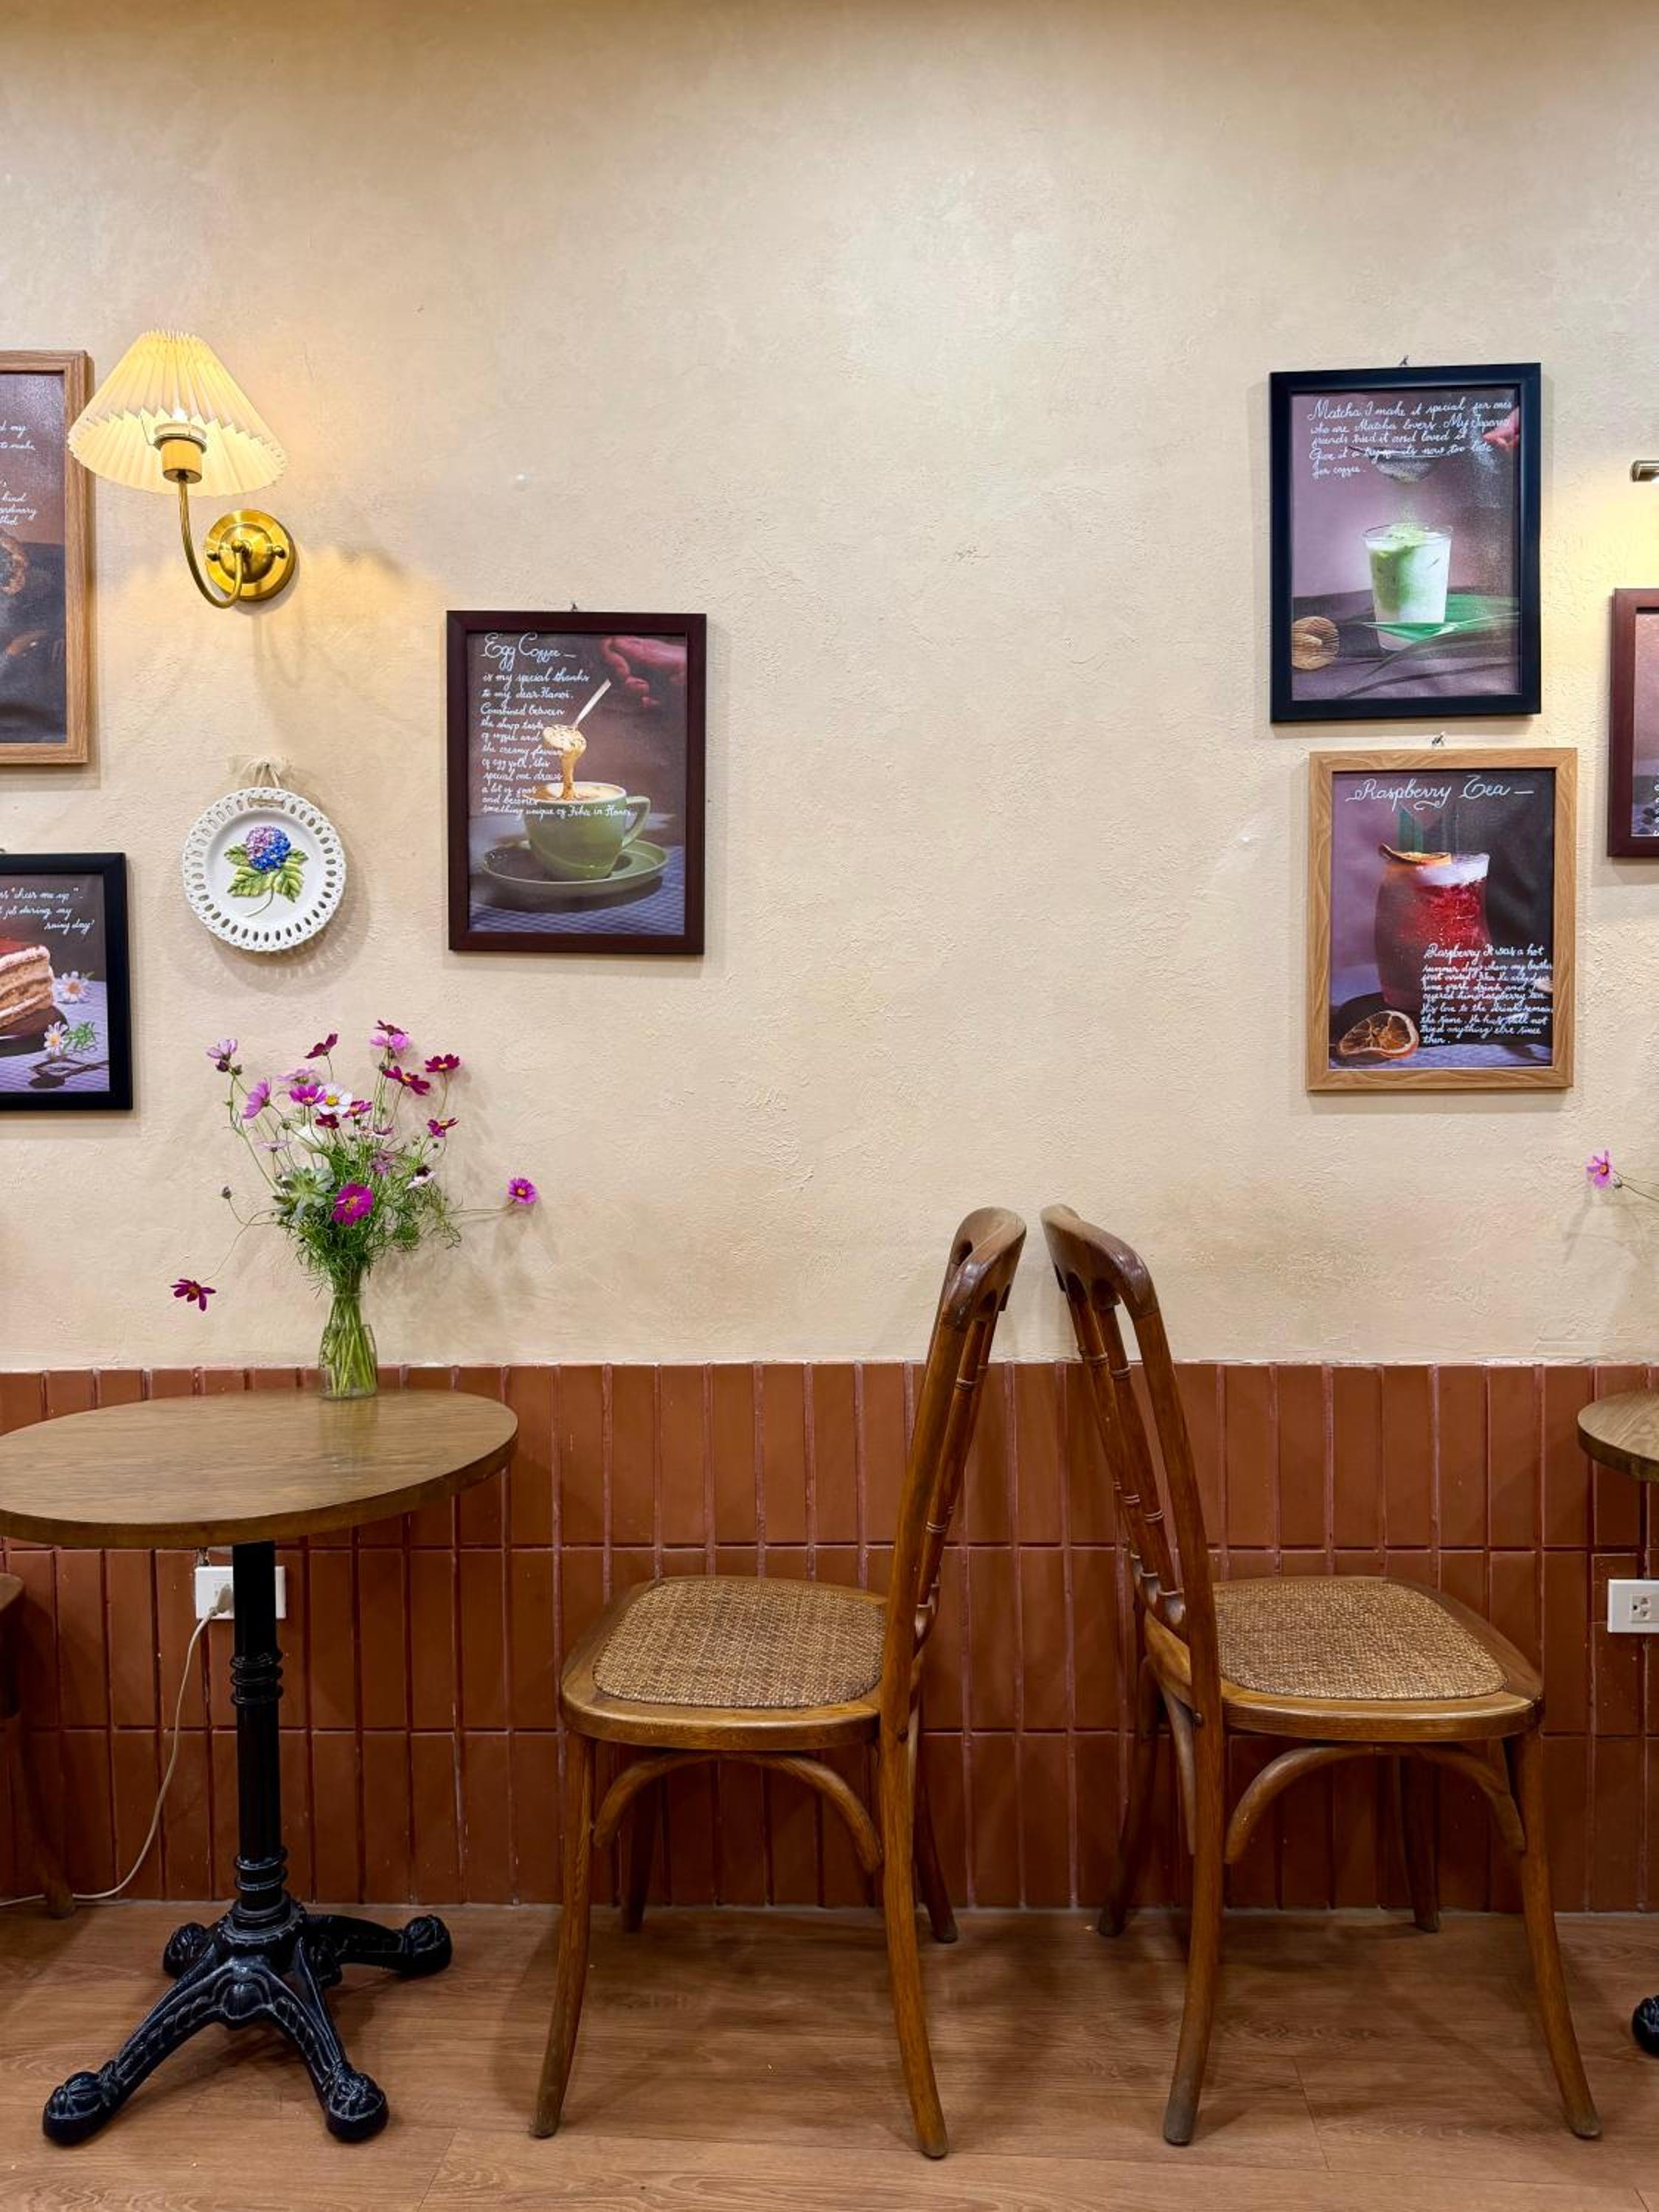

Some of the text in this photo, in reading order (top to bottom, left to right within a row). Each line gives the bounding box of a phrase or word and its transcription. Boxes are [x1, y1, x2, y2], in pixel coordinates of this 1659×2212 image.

[1426, 397, 1465, 421] special
[1354, 417, 1397, 431] Matcha
[1391, 430, 1417, 443] and
[1421, 430, 1450, 442] loved
[1446, 444, 1465, 456] too
[482, 633, 560, 671] Egg Coffee
[495, 674, 512, 691] my
[515, 667, 550, 692] special
[494, 691, 512, 708] my
[481, 702, 566, 716] Combined between
[481, 715, 494, 727] the
[520, 731, 543, 742] and
[483, 742, 496, 752] the
[484, 768, 515, 786] special
[482, 794, 501, 803] and
[1345, 774, 1511, 812] Raspberry Tea
[594, 806, 603, 815] in
[55, 908, 73, 921] my
[1424, 942, 1481, 966] Raspberry
[1526, 944, 1545, 956] hot
[1472, 1001, 1486, 1012] the
